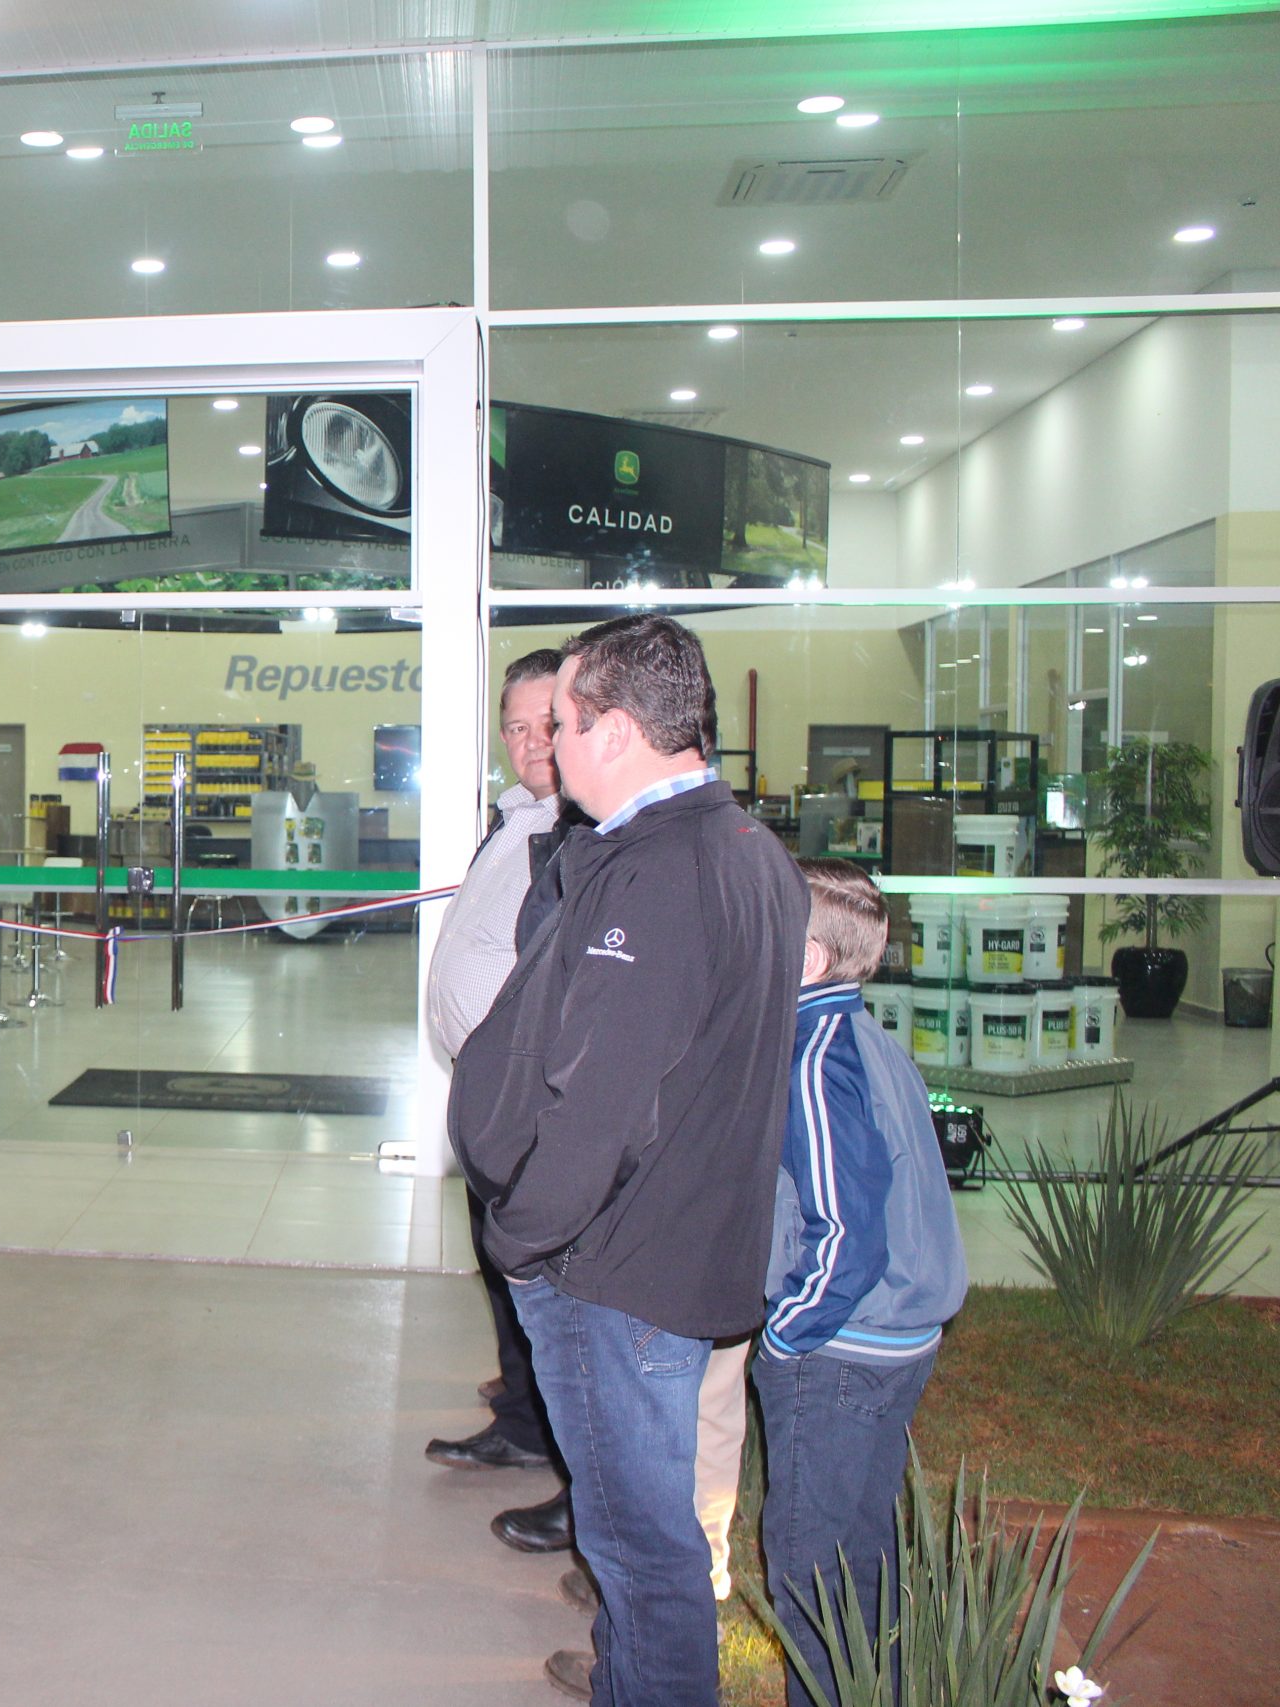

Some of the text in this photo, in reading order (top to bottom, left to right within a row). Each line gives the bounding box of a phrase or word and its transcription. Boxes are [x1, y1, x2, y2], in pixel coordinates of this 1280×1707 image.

[568, 504, 673, 534] CALIDAD
[77, 545, 105, 560] CON
[110, 541, 128, 555] LA
[988, 939, 1020, 950] HY-GARD
[586, 945, 636, 963] Mercedes-Benz
[987, 1024, 1017, 1036] PLUS-50
